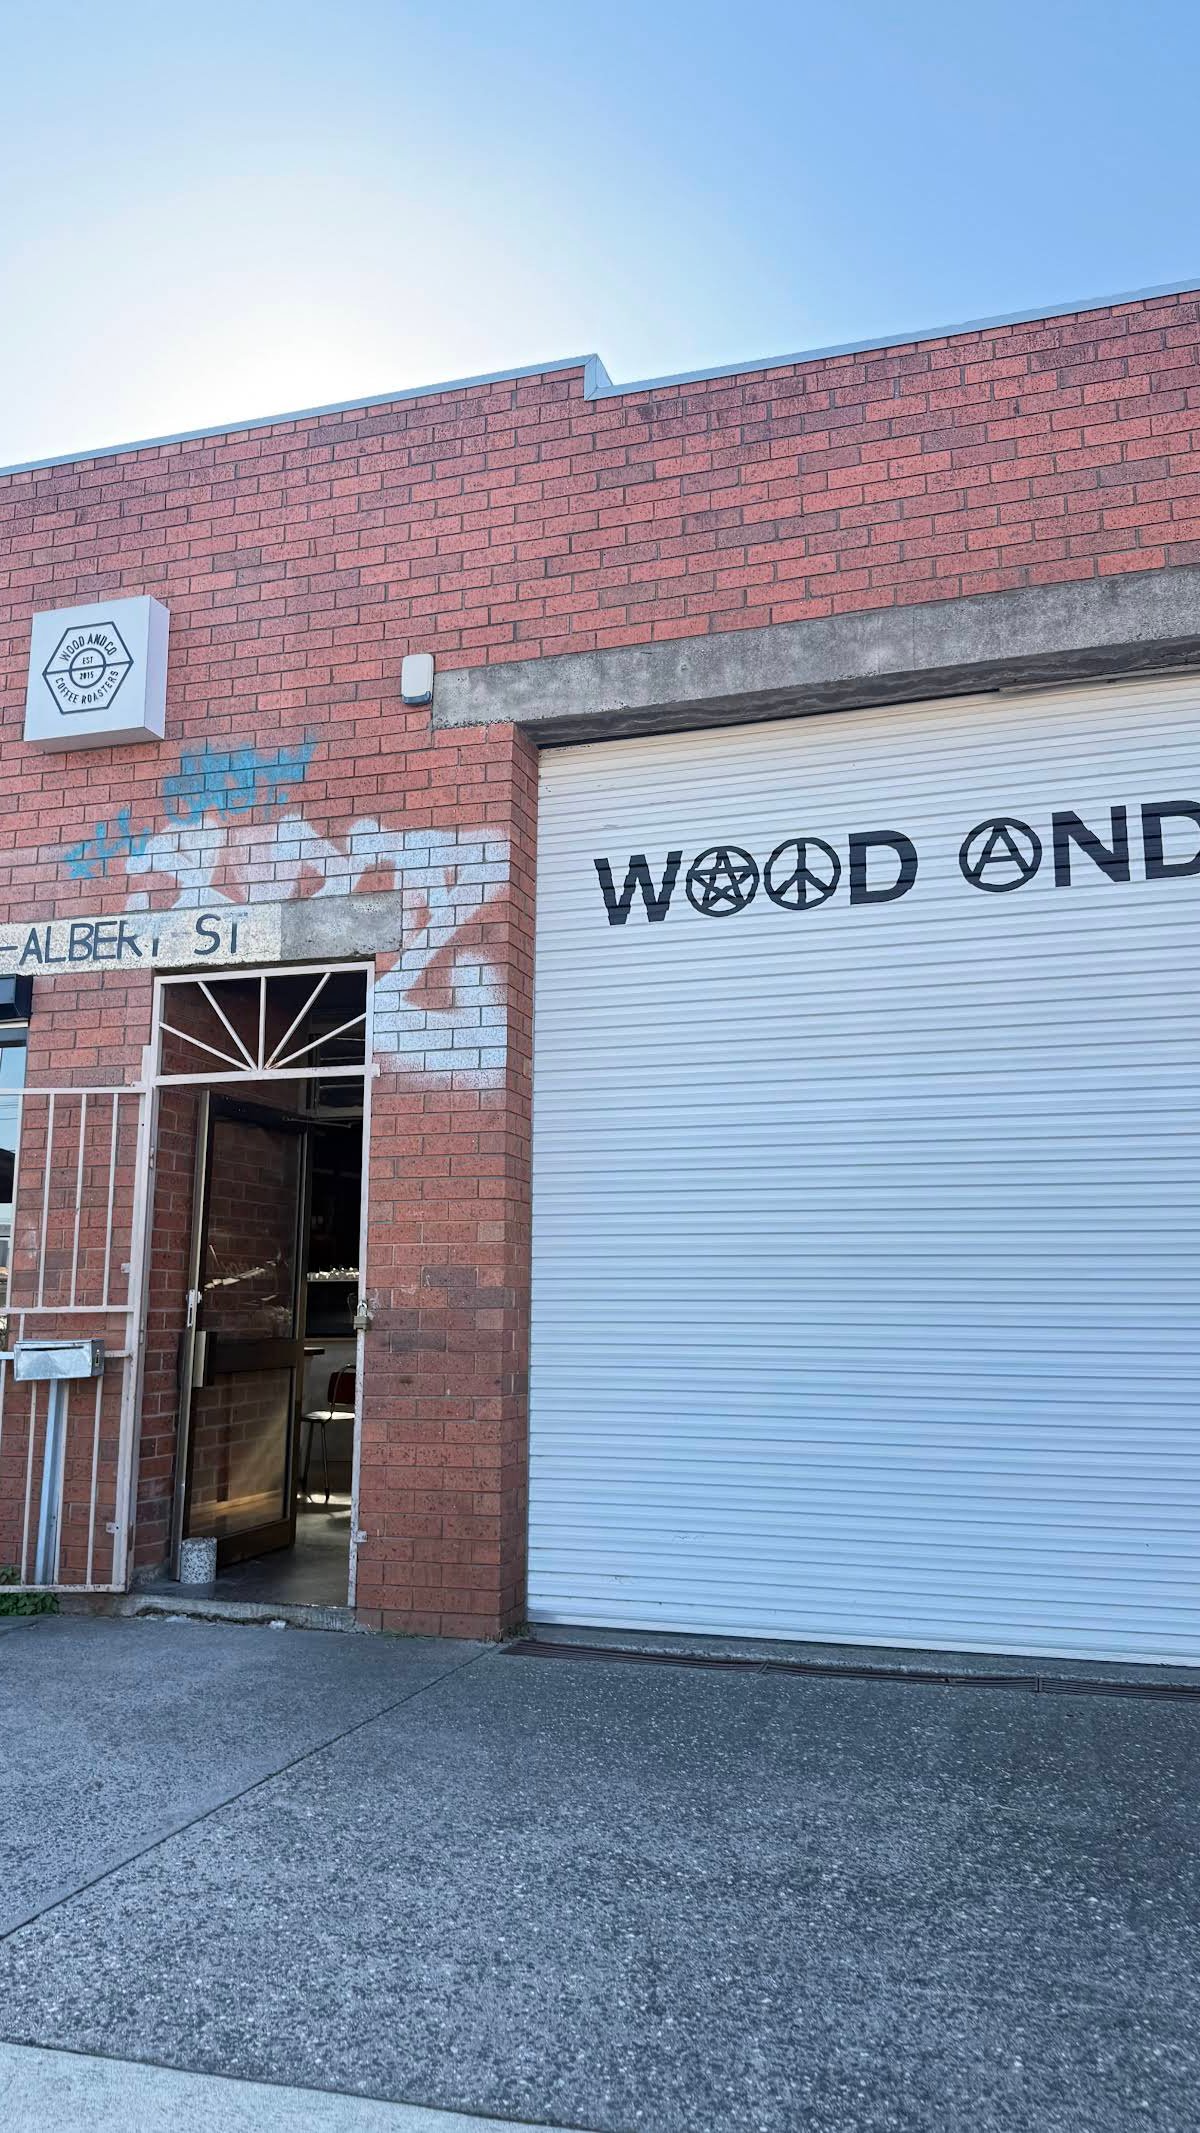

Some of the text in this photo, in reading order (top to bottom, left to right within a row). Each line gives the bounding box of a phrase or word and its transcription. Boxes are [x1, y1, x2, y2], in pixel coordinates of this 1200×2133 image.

[59, 635, 85, 662] WOOD
[82, 656, 94, 665] EST
[55, 670, 119, 705] COFFEE ROASTERS
[79, 671, 94, 680] 2015
[194, 911, 248, 956] ST
